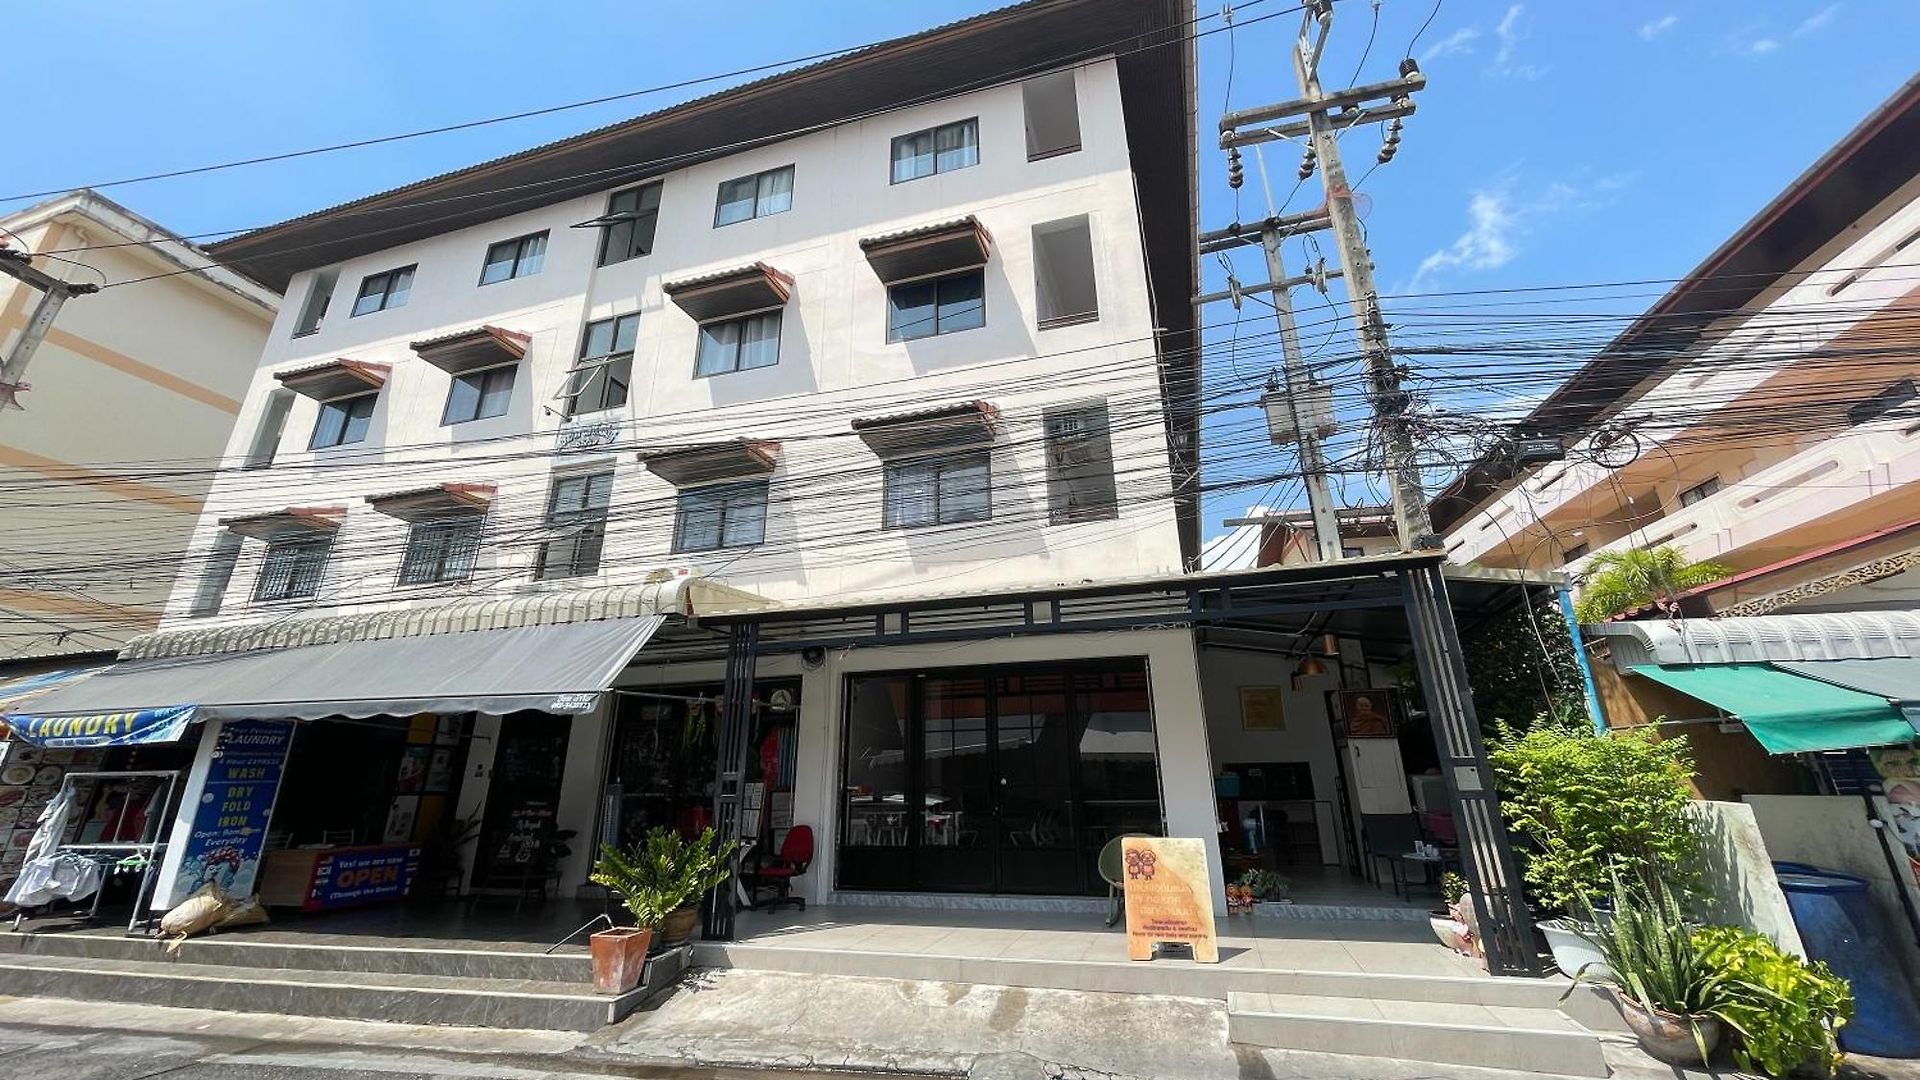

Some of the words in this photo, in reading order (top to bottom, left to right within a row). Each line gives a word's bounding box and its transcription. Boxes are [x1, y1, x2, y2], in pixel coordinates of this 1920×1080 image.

[29, 712, 140, 737] LAUNDRY
[226, 734, 286, 745] LAUNDRY
[228, 767, 266, 779] WASH
[227, 786, 255, 798] DRY
[221, 800, 252, 812] FOLD
[217, 815, 249, 828] IRON
[336, 866, 399, 888] OPEN
